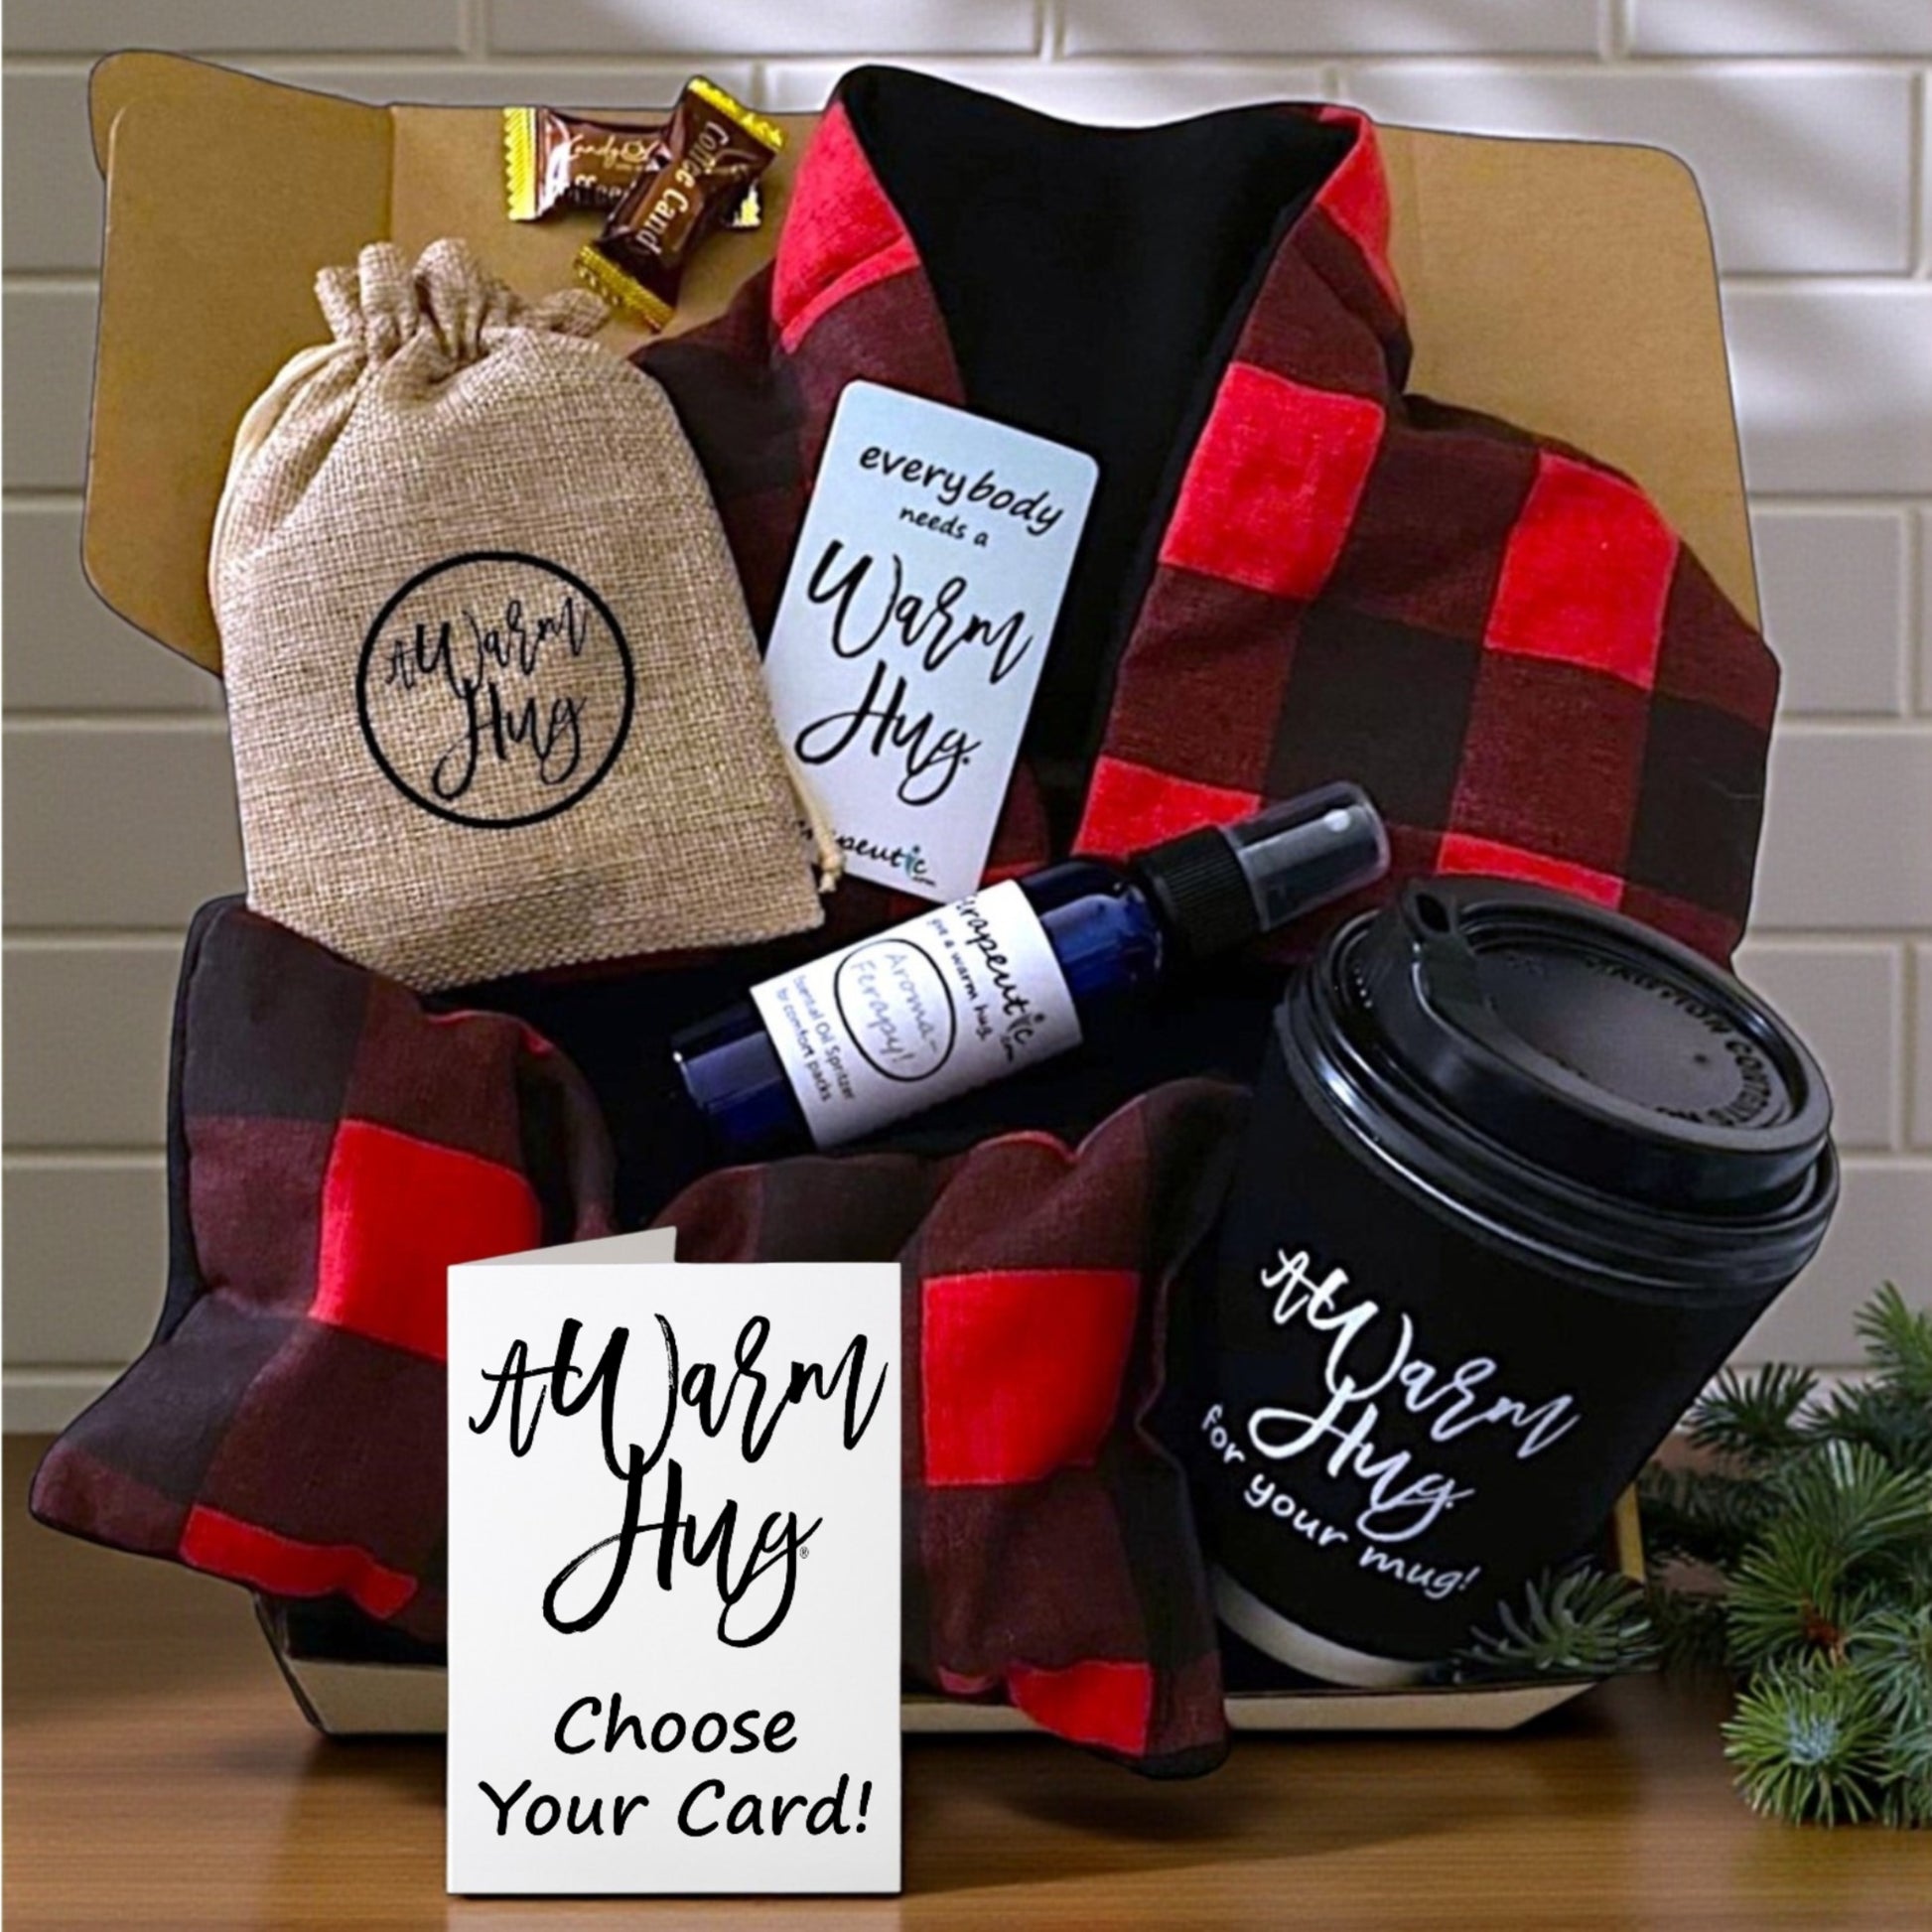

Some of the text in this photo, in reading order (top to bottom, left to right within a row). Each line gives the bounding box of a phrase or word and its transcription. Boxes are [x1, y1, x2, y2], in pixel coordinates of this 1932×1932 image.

[674, 120, 730, 190] Coffee
[633, 188, 689, 256] Cand
[859, 446, 1064, 537] everybody
[898, 506, 989, 548] needs a
[385, 597, 588, 699] A Warm
[807, 539, 1035, 685] Warm
[432, 678, 588, 801] Hug
[851, 960, 916, 1063] Ferapy!
[950, 951, 979, 1001] warm
[784, 1004, 815, 1058] comfort
[805, 1050, 830, 1102] packs
[814, 1018, 835, 1045] Oil
[824, 1043, 856, 1100] Spritzer
[469, 1312, 890, 1481] A Warm
[1261, 1248, 1581, 1459] A Warm
[1200, 1403, 1481, 1600] for your mug!
[554, 1692, 799, 1755] Choose
[478, 1773, 874, 1838] Your Card!
